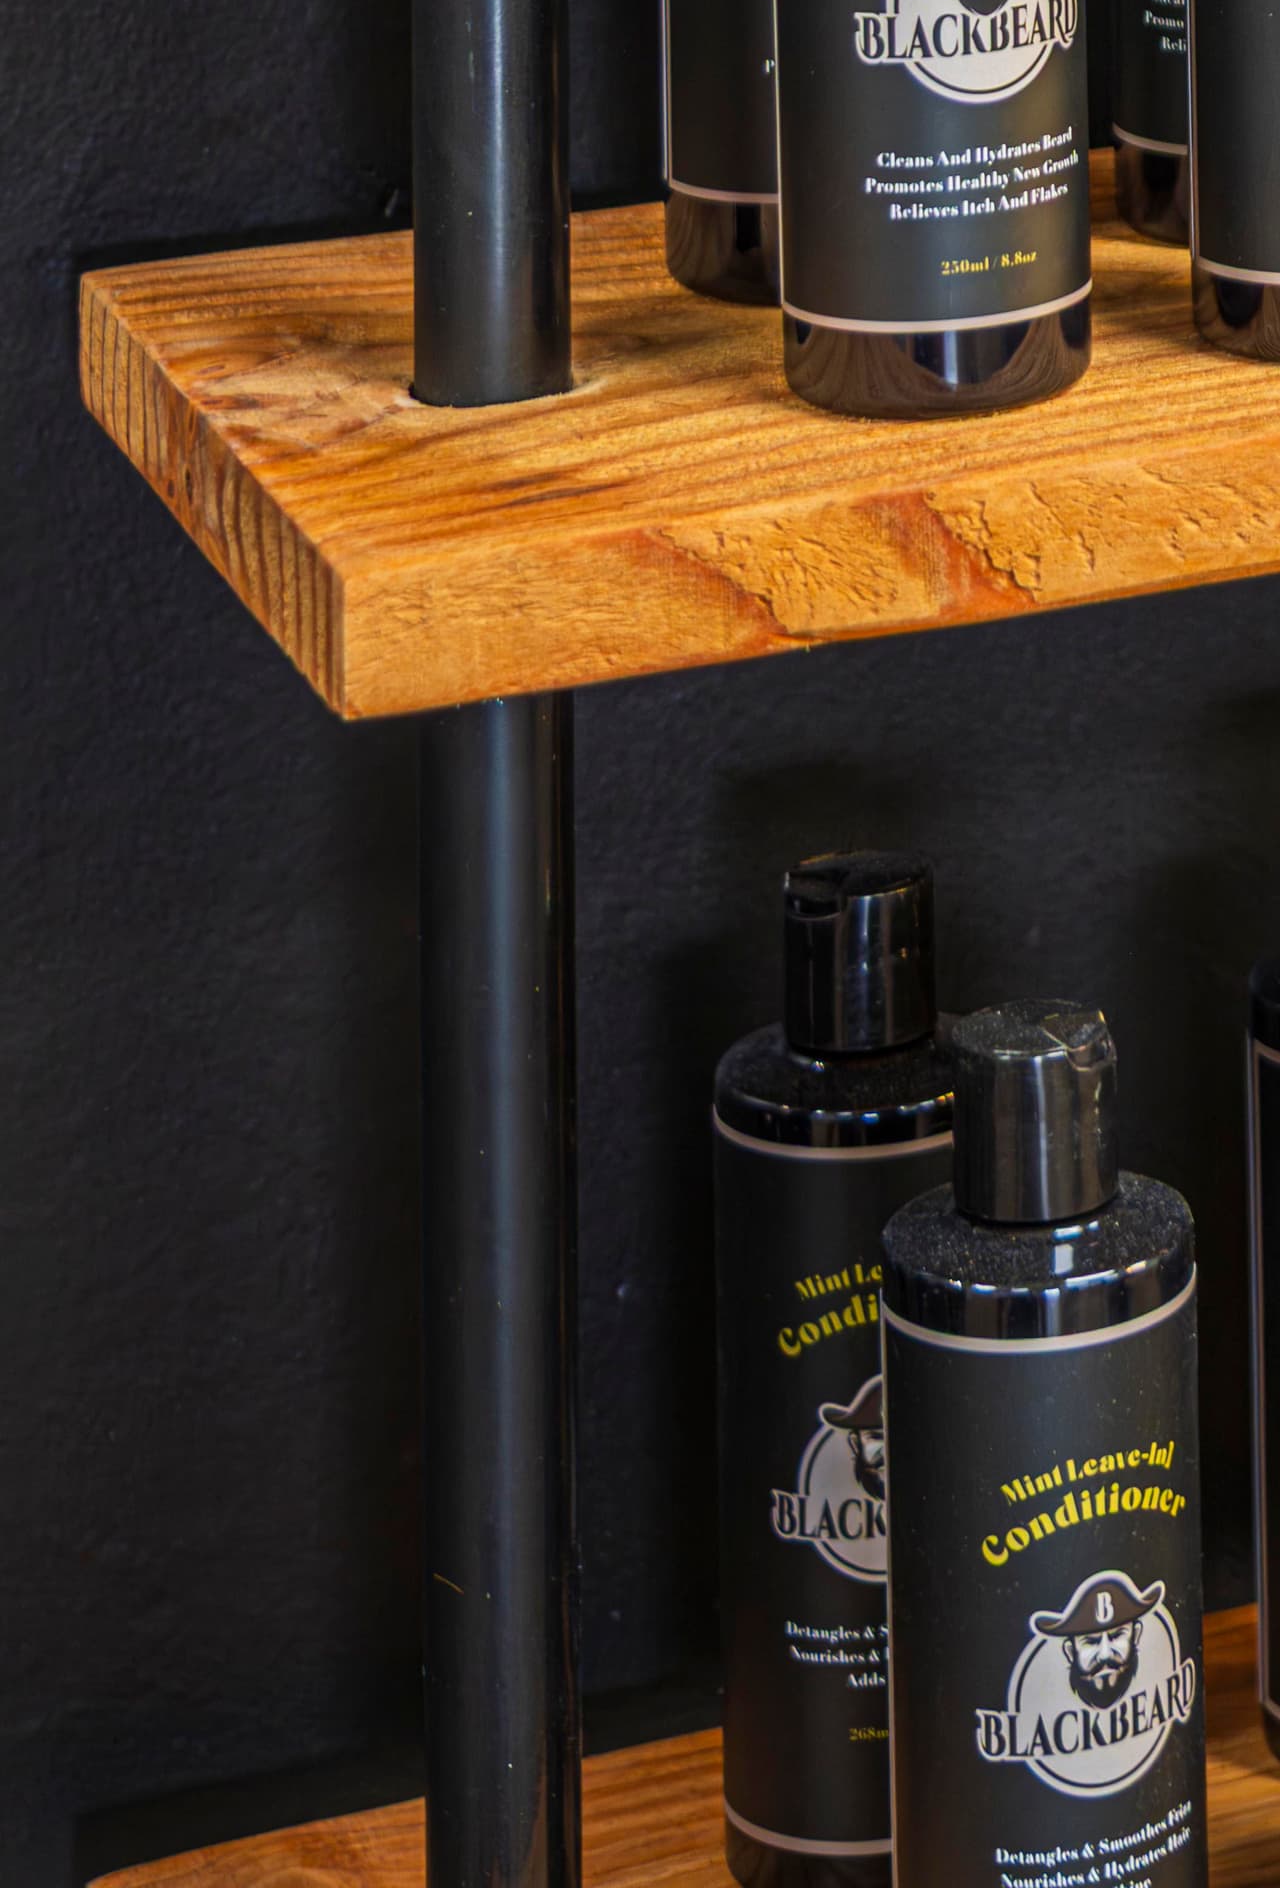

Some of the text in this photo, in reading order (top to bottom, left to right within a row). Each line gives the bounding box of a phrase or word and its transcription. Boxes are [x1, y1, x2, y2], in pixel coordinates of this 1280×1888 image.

[877, 125, 1072, 168] Cleans And Hydrates Beard
[865, 170, 1010, 194] Promotes Healthy
[890, 183, 1068, 220] Relieves Itch And Flakes
[941, 256, 989, 275] 250ml
[1000, 1464, 1063, 1506] Mint
[981, 1482, 1186, 1567] Conditioner
[977, 1659, 1196, 1761] BLACKBEARD
[994, 1820, 1167, 1868] Detangles Smoothes
